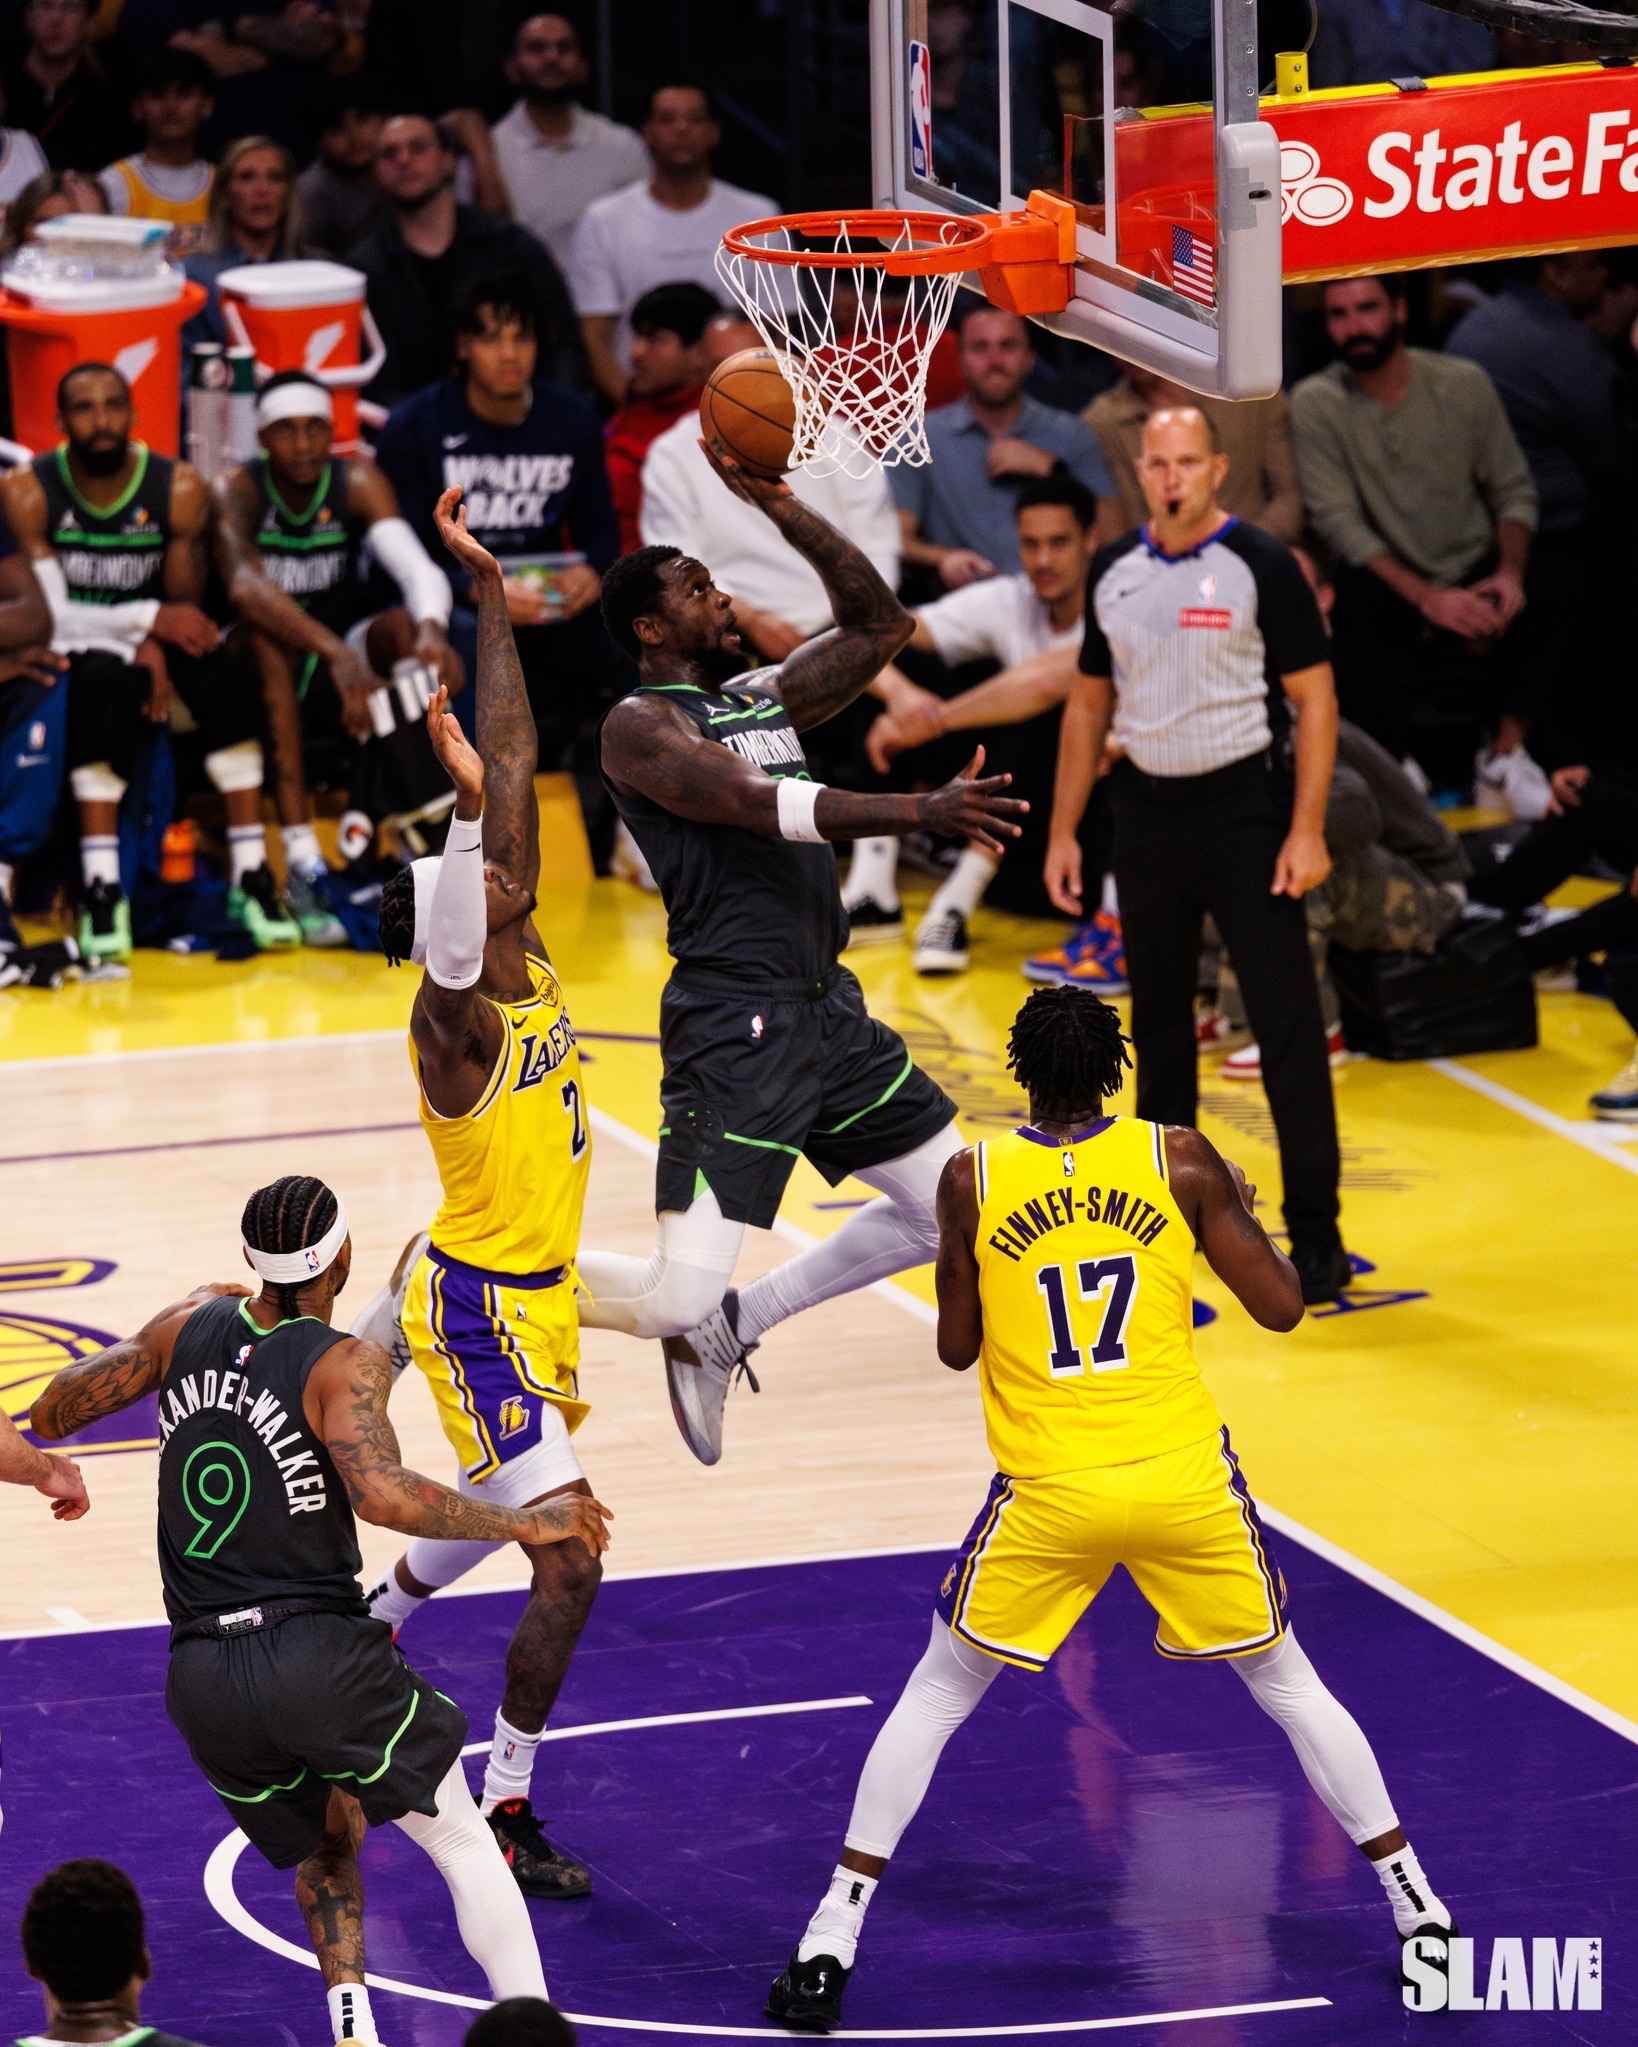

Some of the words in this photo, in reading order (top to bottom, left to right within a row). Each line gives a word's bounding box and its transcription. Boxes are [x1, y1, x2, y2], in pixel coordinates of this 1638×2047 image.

[1363, 120, 1574, 219] State
[465, 491, 550, 530] BACK
[988, 1186, 1169, 1262] FINNEY-SMITH
[1035, 1253, 1140, 1379] 17
[182, 1441, 251, 1559] 9
